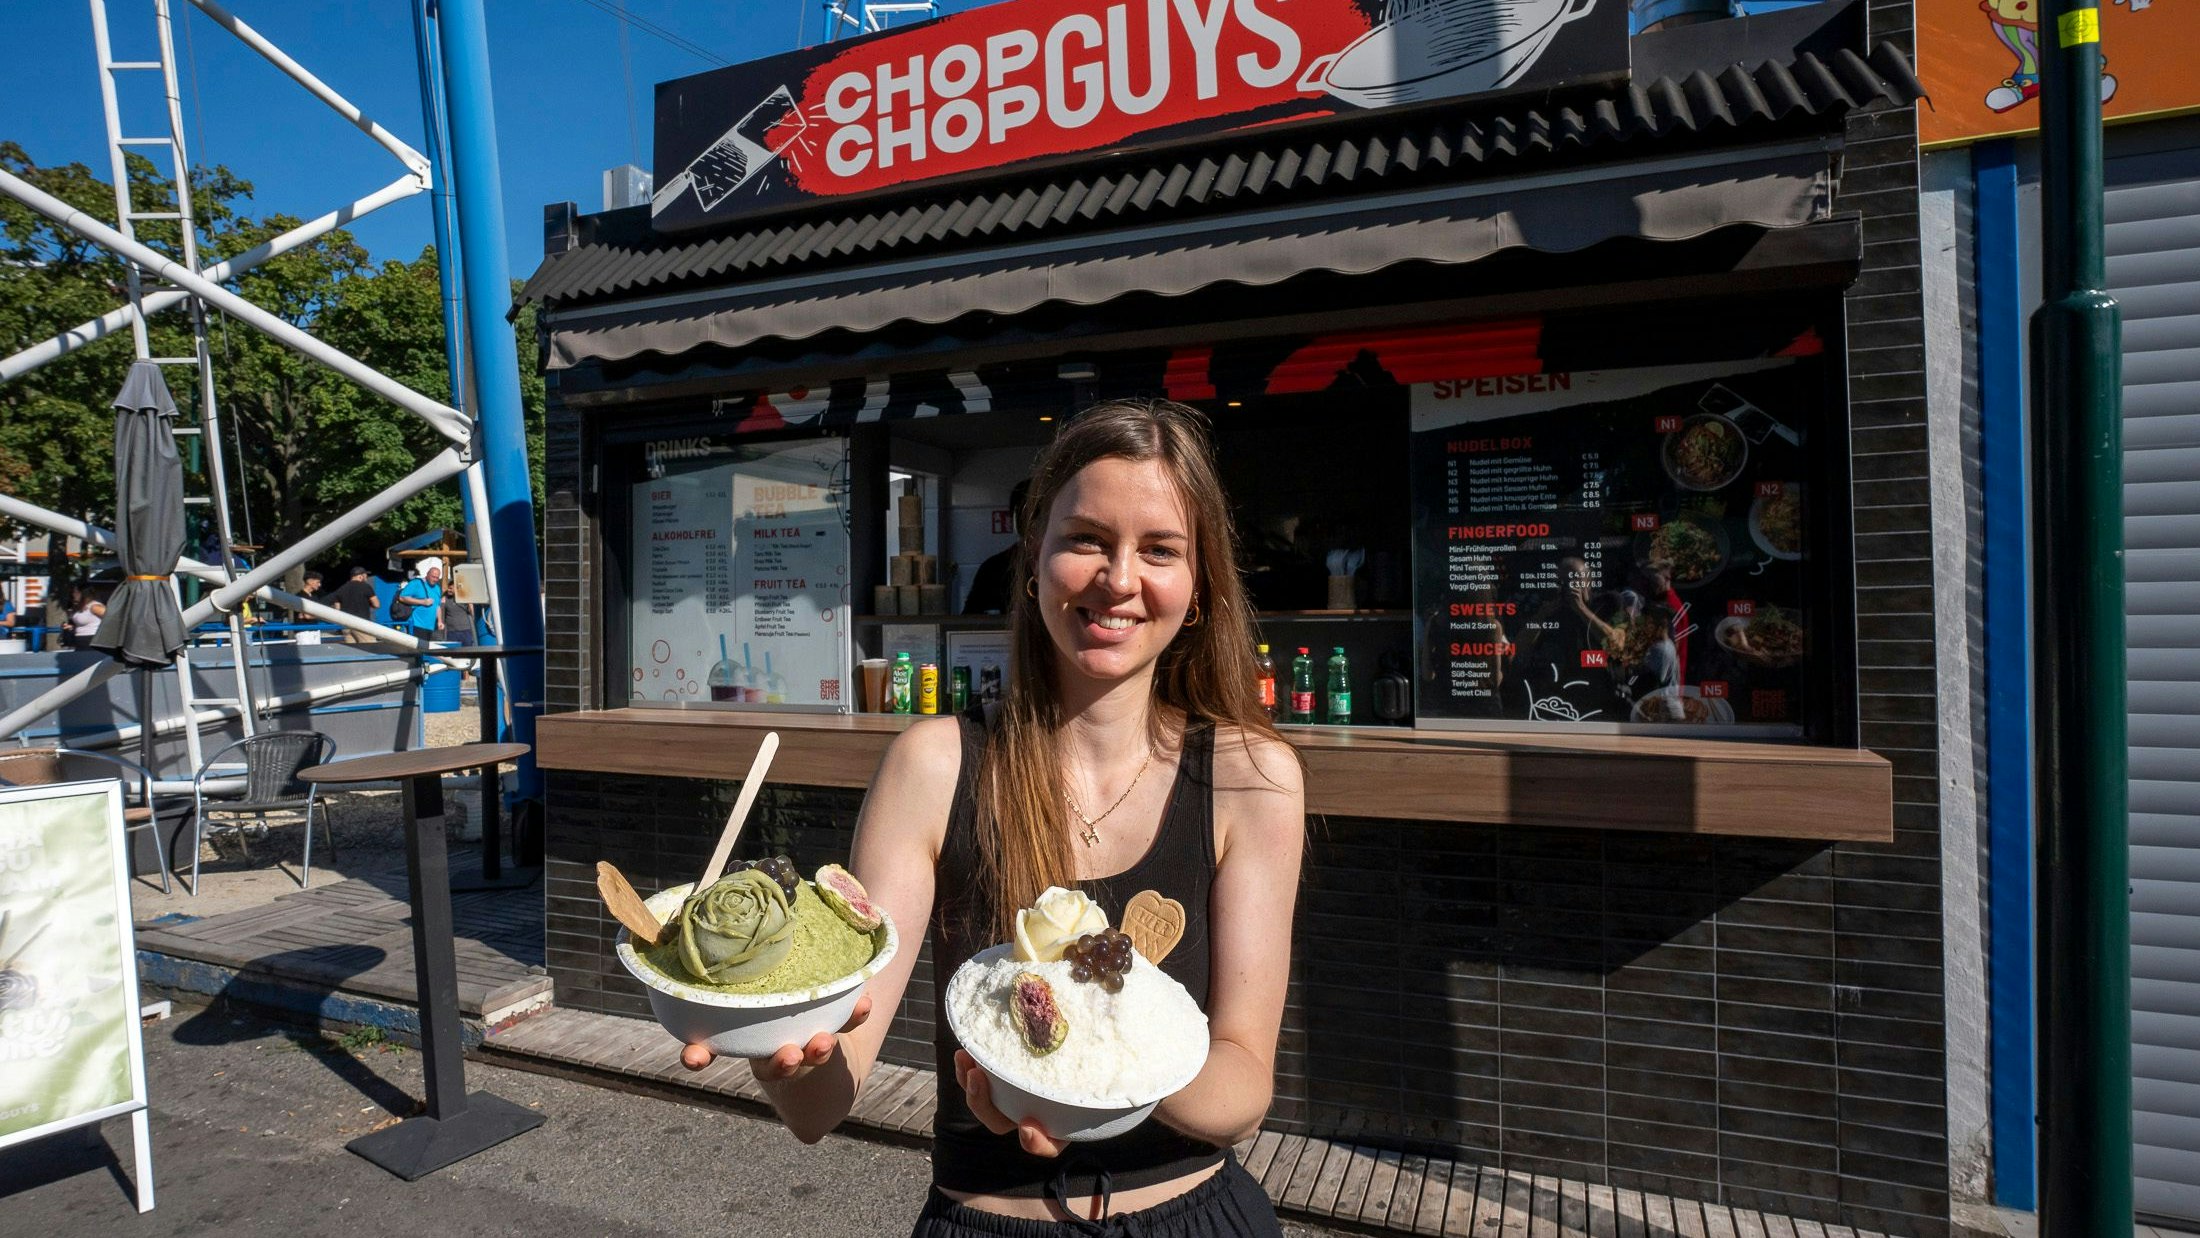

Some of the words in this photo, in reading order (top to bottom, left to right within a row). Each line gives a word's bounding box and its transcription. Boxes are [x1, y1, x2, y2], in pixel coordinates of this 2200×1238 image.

[1045, 0, 1301, 129] GUYS
[825, 29, 1039, 124] CHOP
[825, 85, 1041, 177] CHOP
[1433, 371, 1570, 399] SPEISEN
[1661, 419, 1676, 429] N1
[645, 437, 711, 460] DRINKS
[1470, 477, 1490, 485] Nudel
[1504, 475, 1538, 483] knusprige
[754, 483, 817, 501] BUBBLE
[1470, 486, 1490, 494] Nudel
[1761, 485, 1780, 495] N2
[755, 502, 785, 519] TEA
[1470, 505, 1490, 513] Nudel
[1528, 502, 1557, 510] Gemüse
[1637, 517, 1654, 528] N3
[652, 530, 716, 541] ALKOHOLFREI
[754, 528, 777, 538] MILK
[781, 528, 800, 537] TEA
[1448, 523, 1550, 539] FINGERFOOD
[1449, 544, 1517, 553] Mini-Frühlingsrollen
[1449, 573, 1477, 581] Chicken
[1478, 573, 1499, 581] Gyoza
[754, 580, 783, 589] FRUIT
[786, 579, 806, 588] TEA
[1470, 583, 1491, 591] Gyoza
[1449, 603, 1517, 617] SWEETS
[1450, 642, 1516, 656] SAUCEN
[1586, 654, 1604, 664] N4
[1451, 661, 1488, 669] Knoblauch
[1452, 680, 1479, 688] Teriyaki
[820, 690, 839, 700] GUYS
[1451, 689, 1474, 697] Sweet
[1704, 685, 1722, 696] N5
